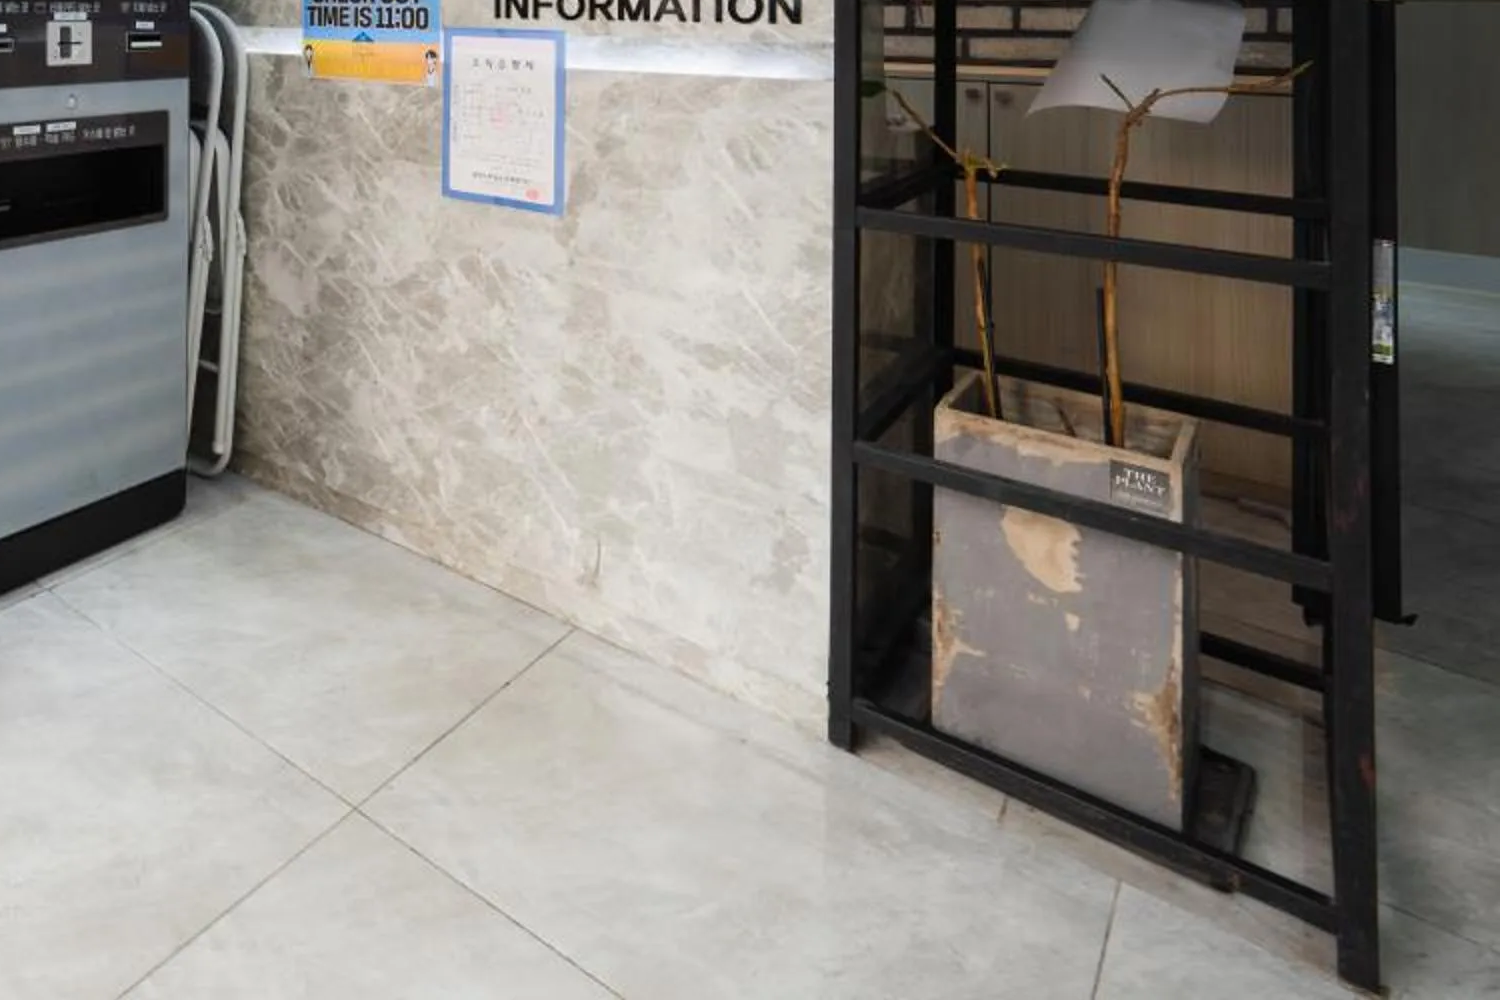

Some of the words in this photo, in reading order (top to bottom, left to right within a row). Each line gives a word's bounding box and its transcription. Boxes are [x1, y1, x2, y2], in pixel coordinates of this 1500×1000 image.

[306, 5, 350, 27] TIME
[353, 6, 372, 28] IS
[375, 6, 429, 30] 11:00
[1115, 475, 1167, 497] PLANT
[1122, 467, 1157, 485] THE
